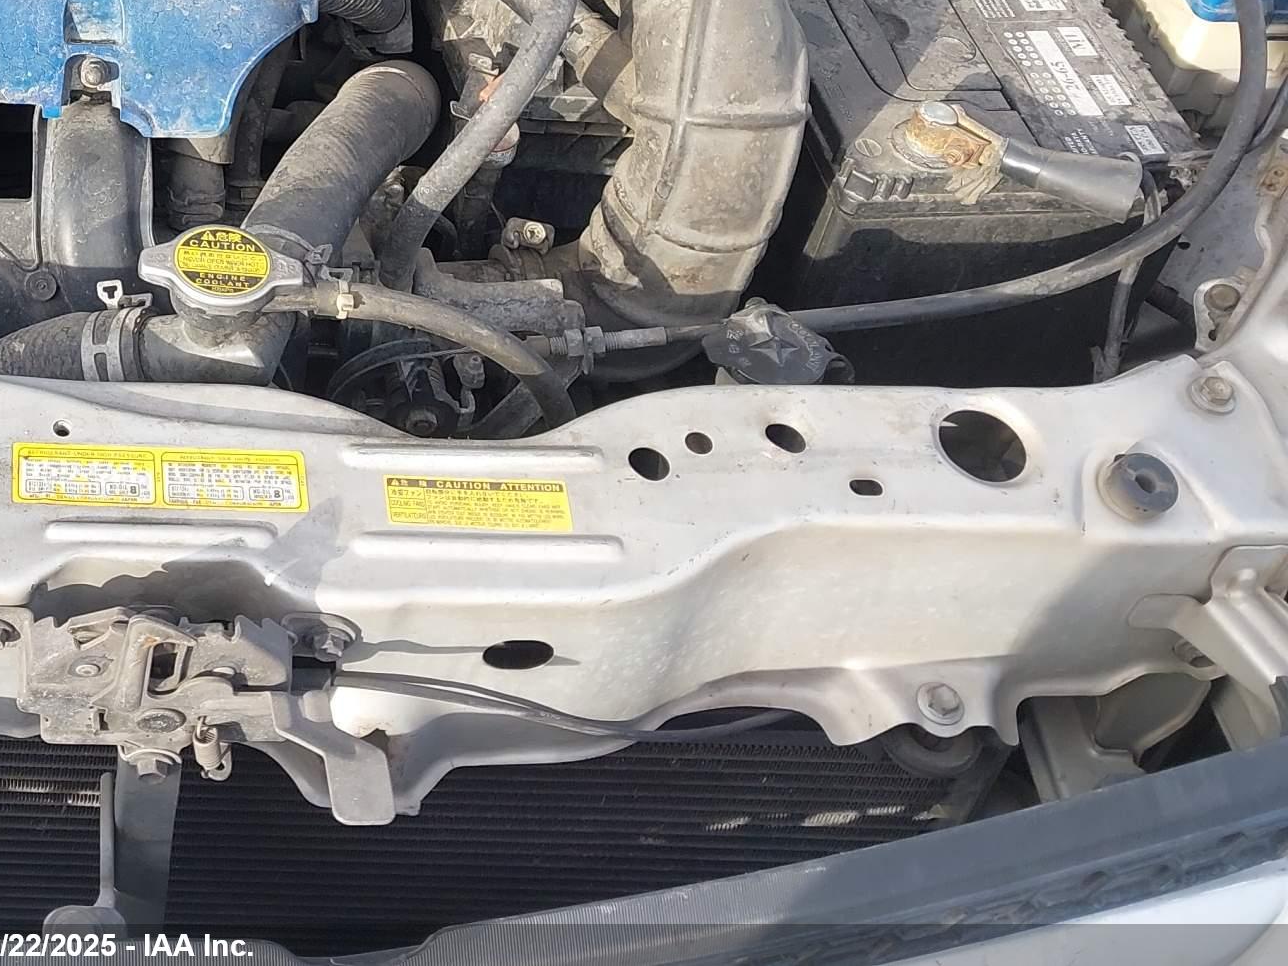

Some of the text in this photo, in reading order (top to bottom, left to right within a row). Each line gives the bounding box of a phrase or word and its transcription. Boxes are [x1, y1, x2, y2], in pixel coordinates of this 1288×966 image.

[189, 240, 255, 251] CAUTION
[196, 278, 249, 287] COOLANT
[200, 273, 246, 282] ENGINE
[436, 481, 491, 490] CAUTION
[500, 483, 560, 492] ATTENTION
